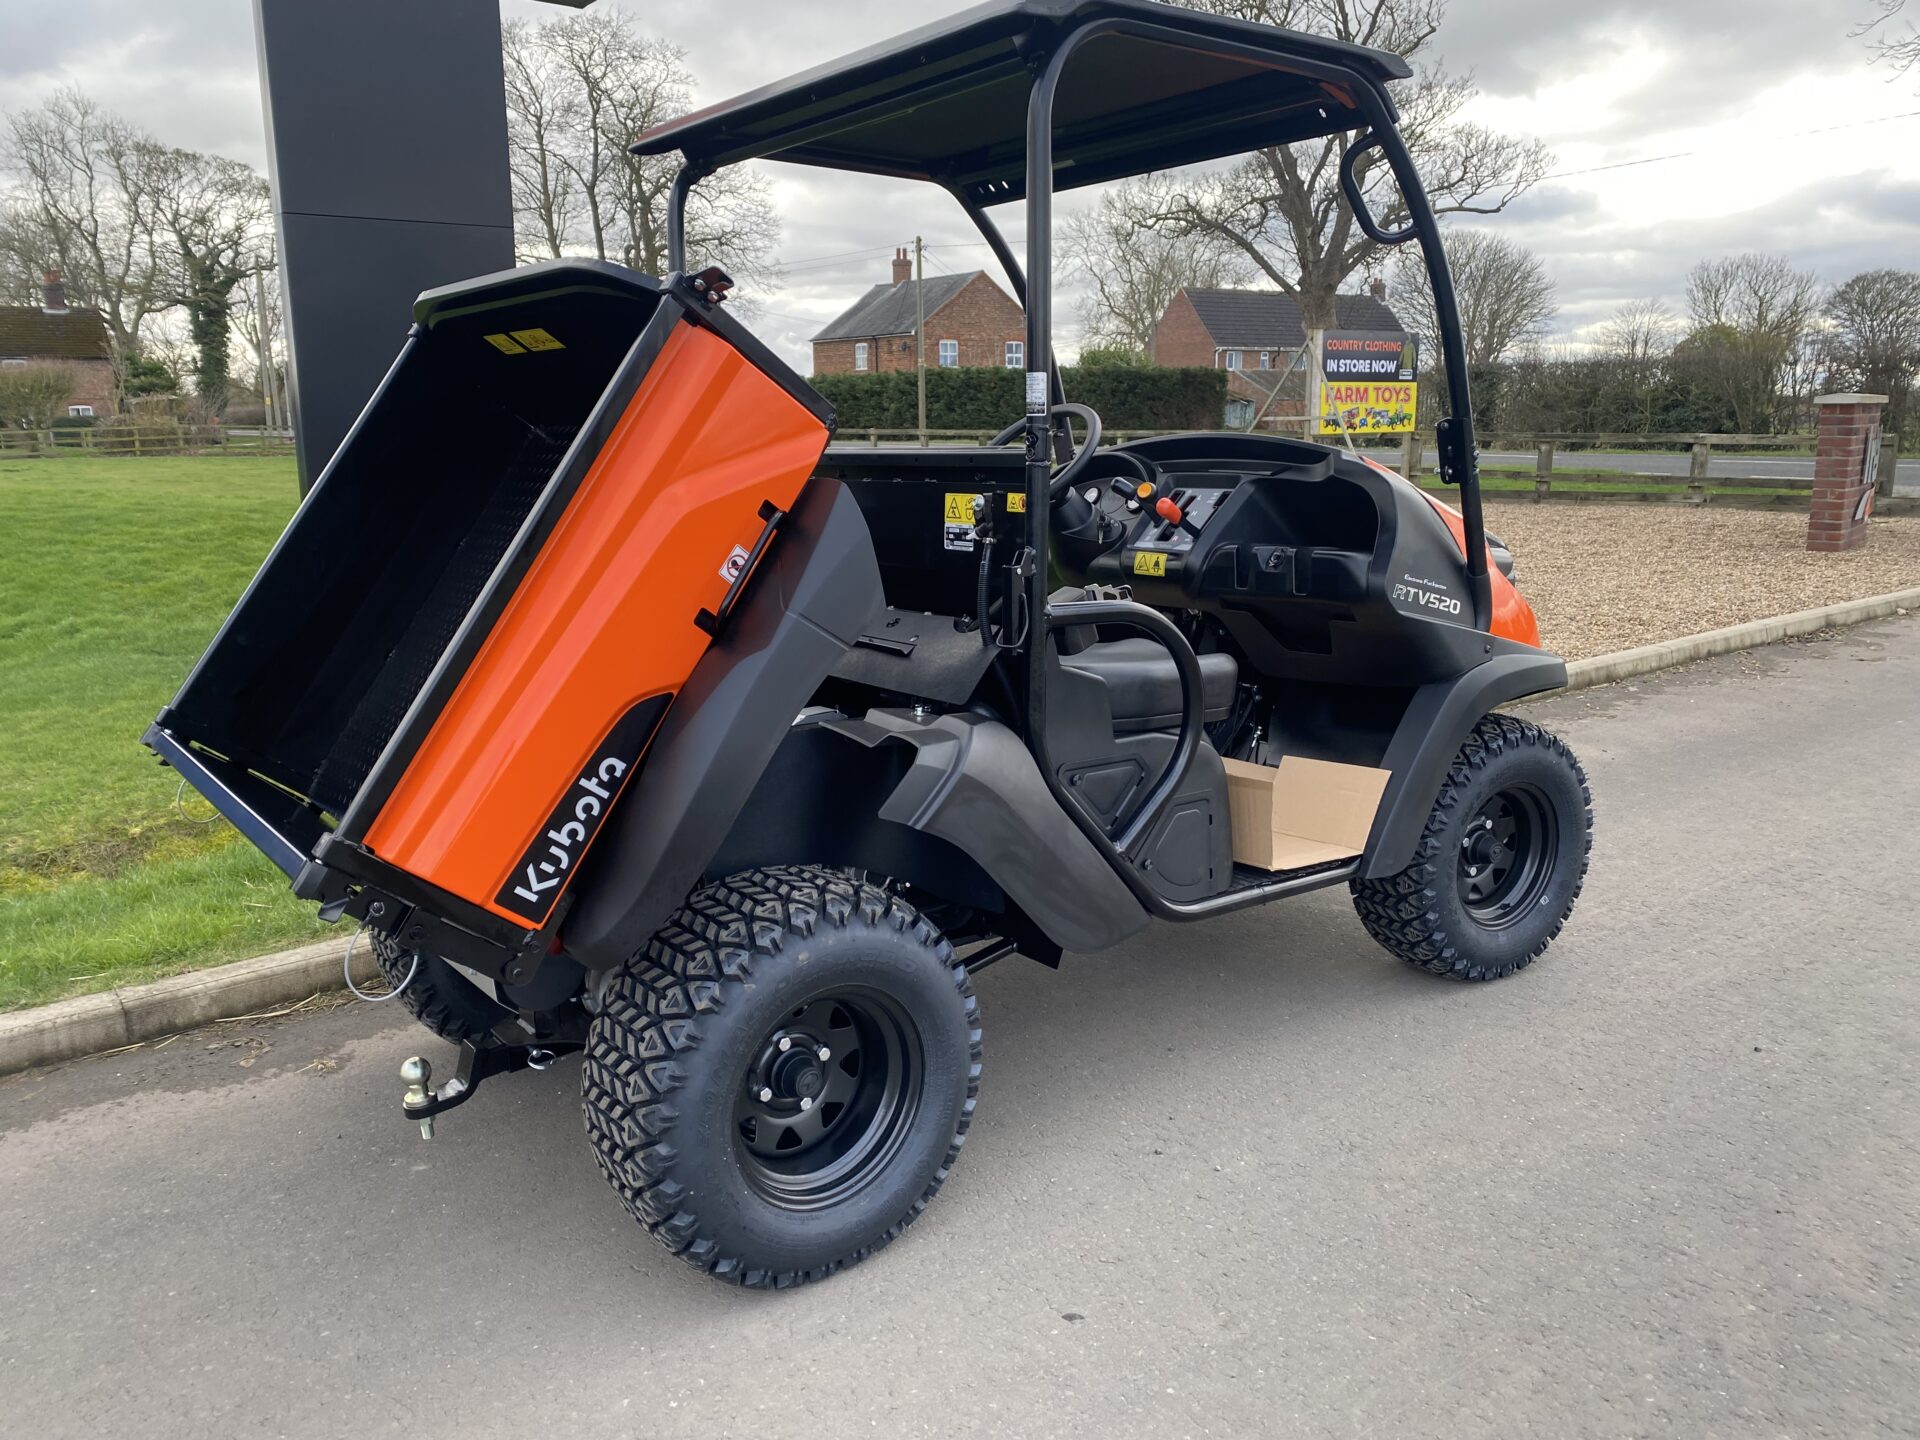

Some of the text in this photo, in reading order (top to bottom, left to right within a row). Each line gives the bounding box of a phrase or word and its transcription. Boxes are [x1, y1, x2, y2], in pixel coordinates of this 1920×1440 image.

[1327, 339, 1402, 352] COUNTRY CLOTHING
[1326, 359, 1397, 373] IN STORE NOW
[1373, 386, 1411, 403] TOYS
[1393, 583, 1461, 614] RTV520
[513, 757, 627, 903] Kubota
